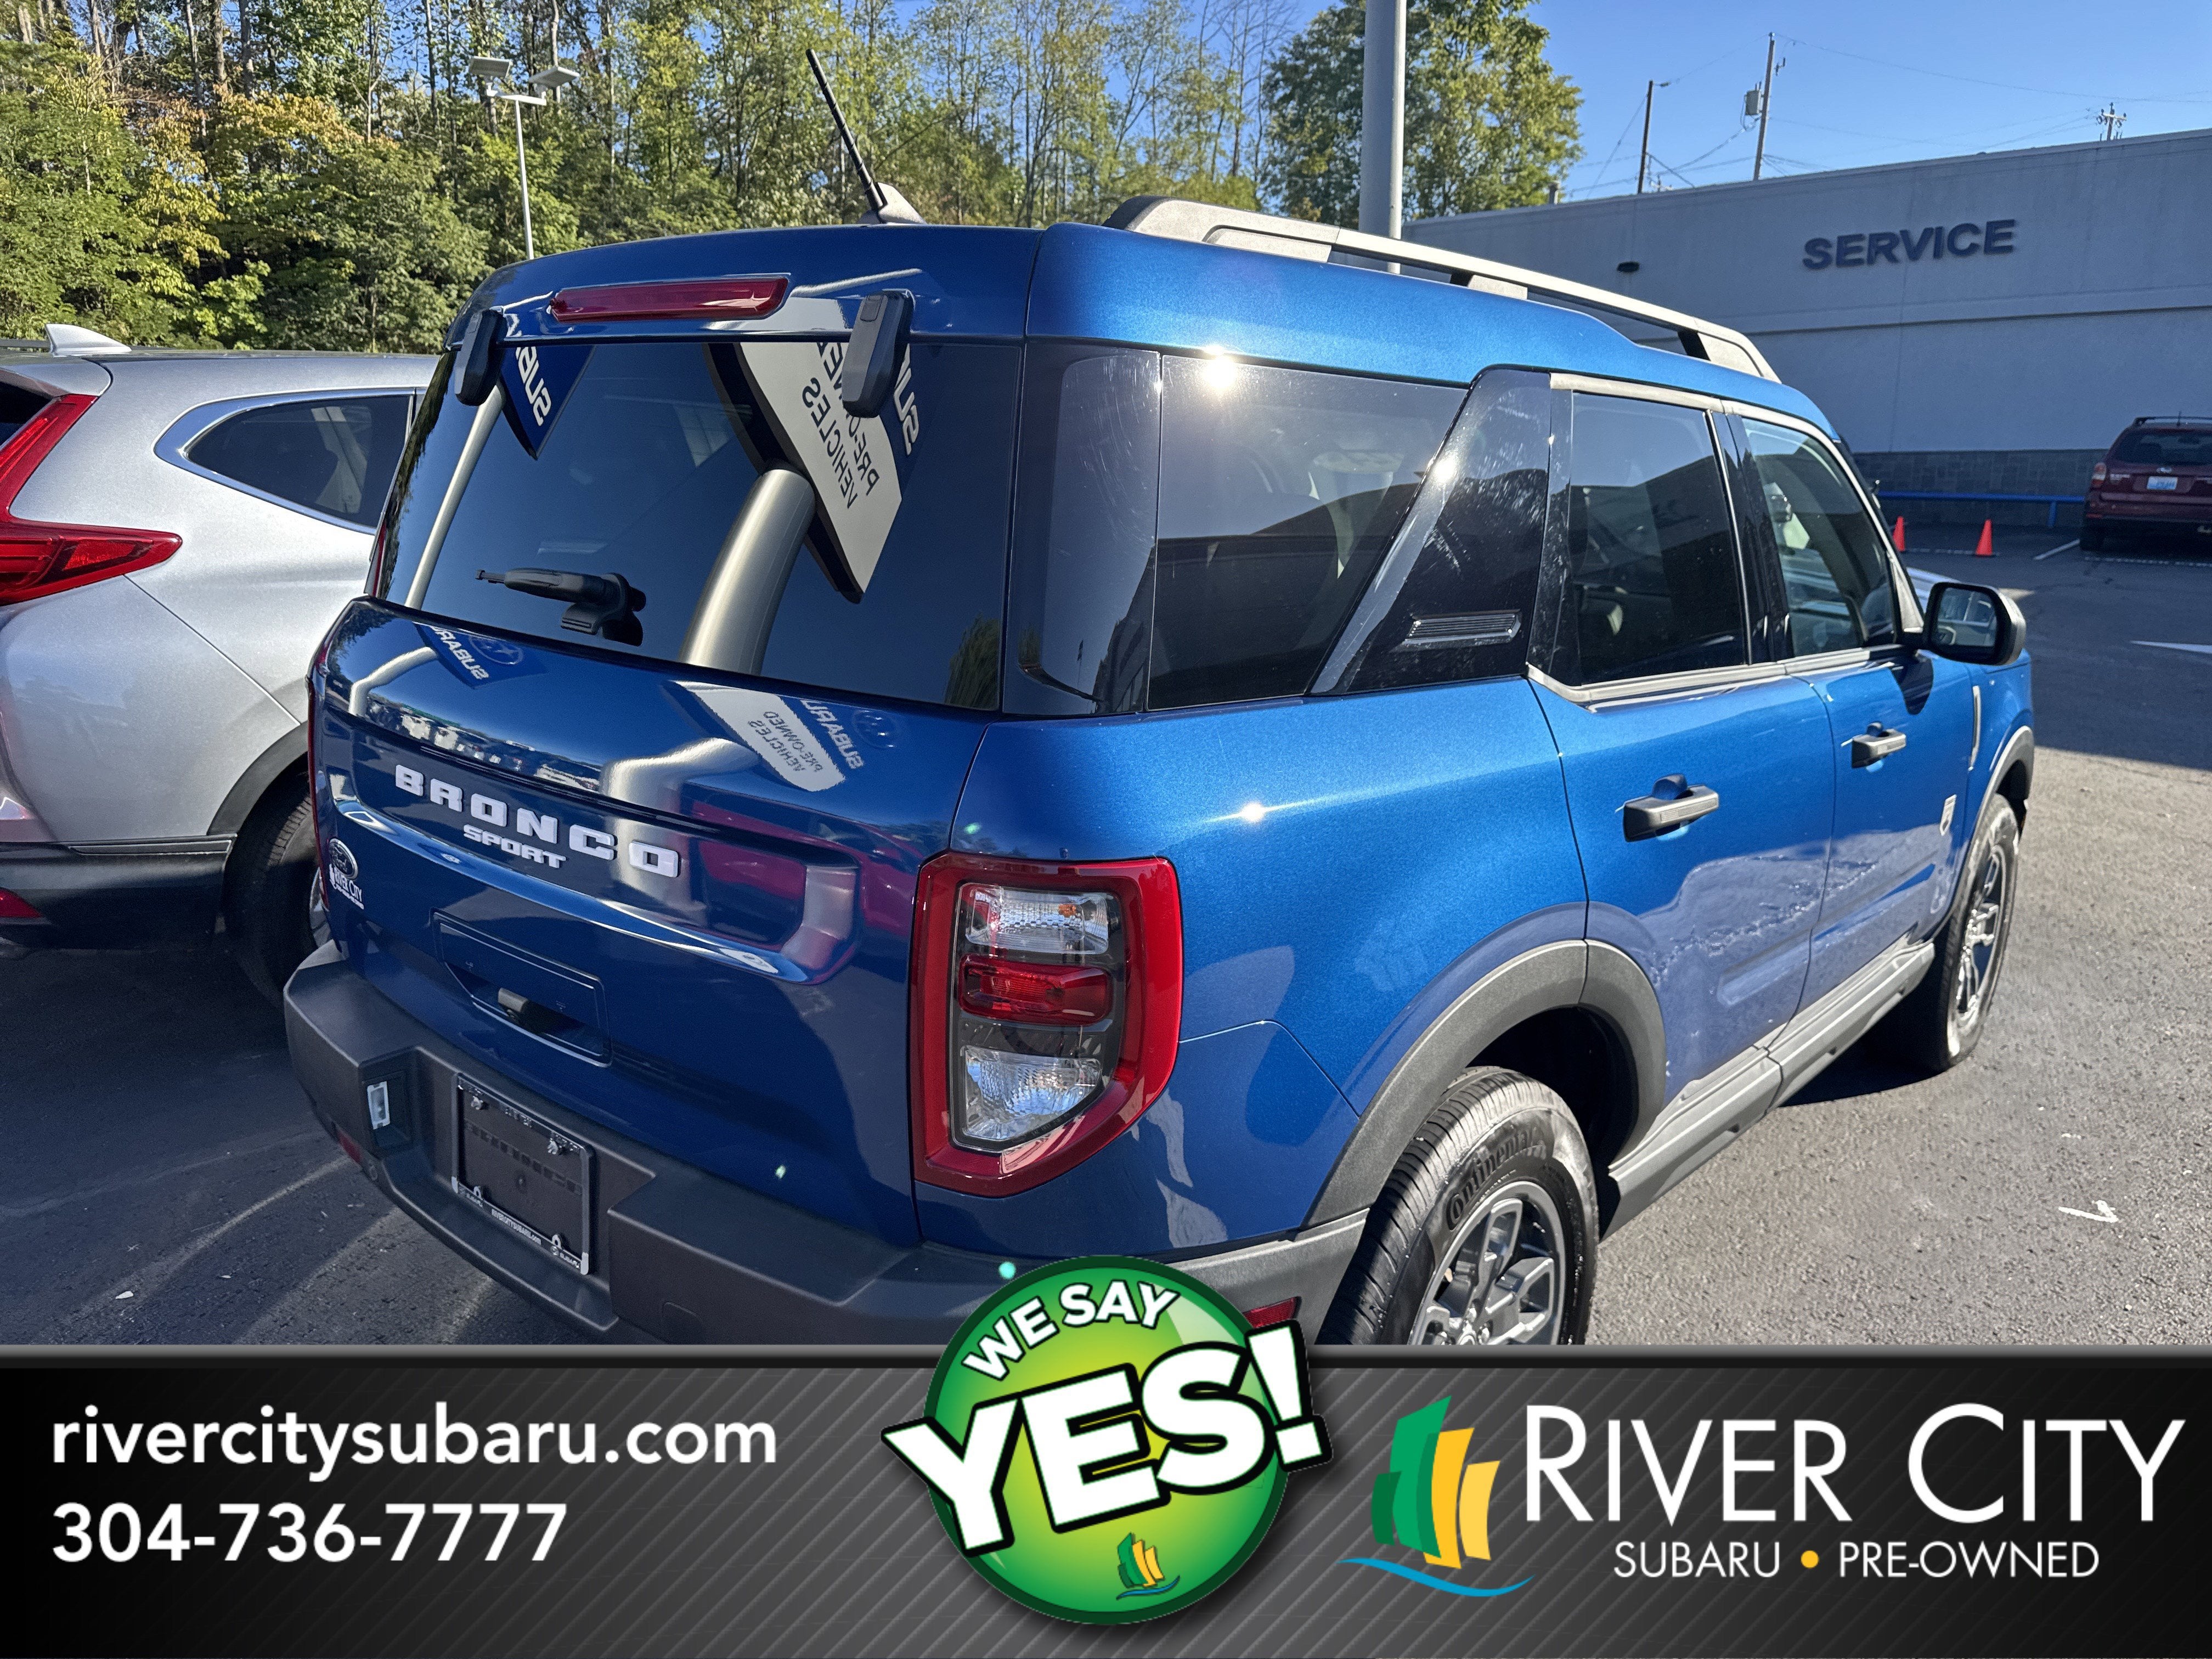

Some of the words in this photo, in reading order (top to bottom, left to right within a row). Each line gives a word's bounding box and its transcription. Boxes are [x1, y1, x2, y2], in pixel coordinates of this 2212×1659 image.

[1803, 219, 2016, 269] SERVICE
[396, 765, 679, 878] BRONCO
[464, 824, 567, 869] SPORT
